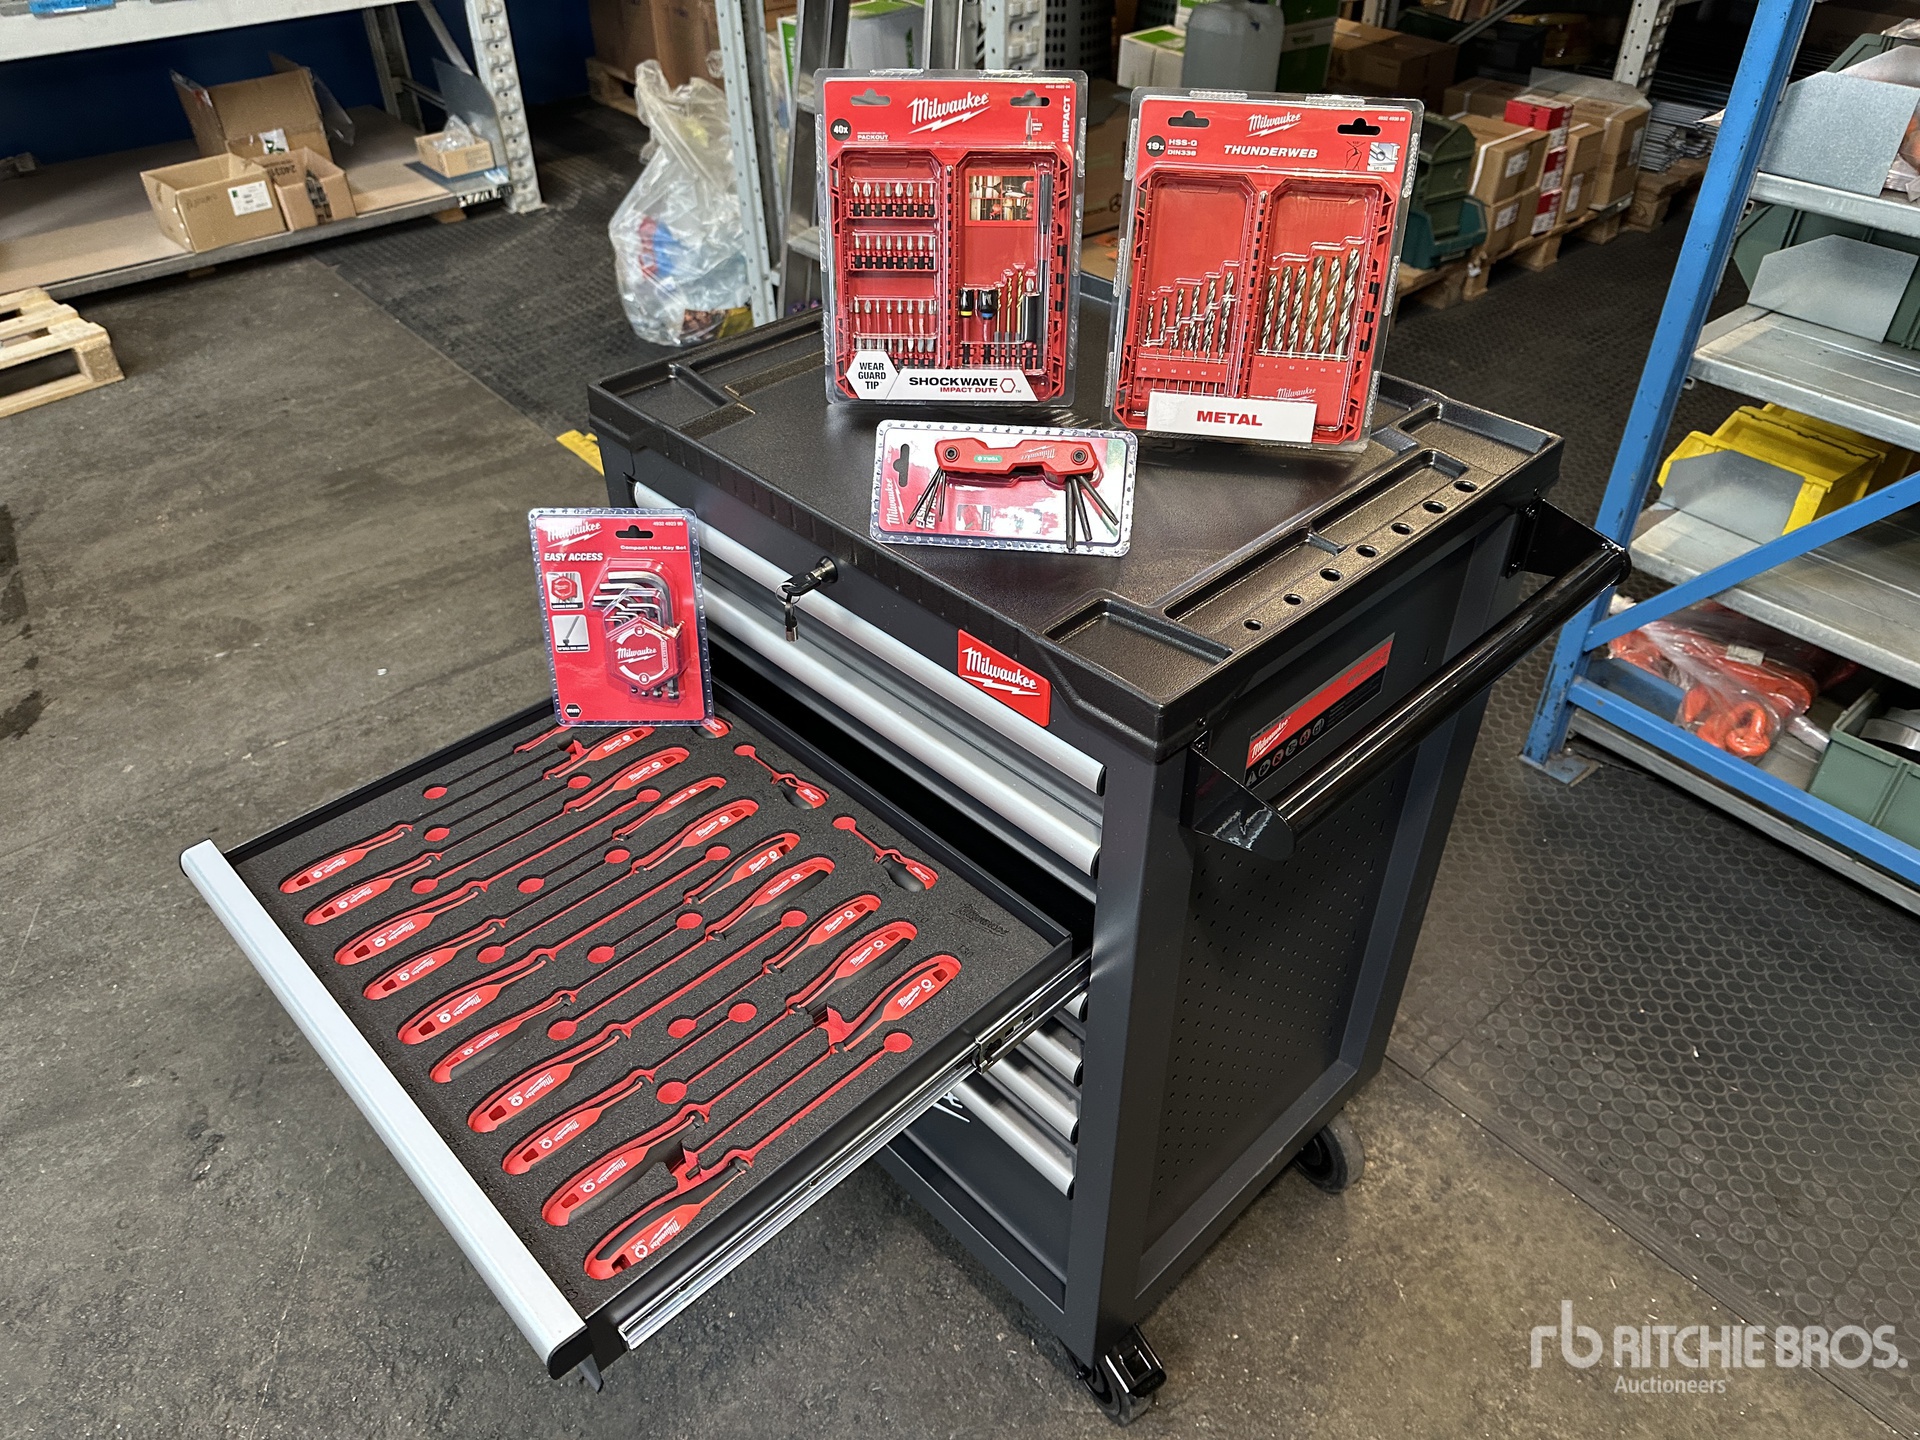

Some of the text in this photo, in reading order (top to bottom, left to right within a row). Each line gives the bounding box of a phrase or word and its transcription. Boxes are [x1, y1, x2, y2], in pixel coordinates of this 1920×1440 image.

[906, 92, 989, 125] Milwaukee
[1062, 96, 1071, 143] IMPACT
[1247, 112, 1302, 132] Milwaukee
[834, 125, 848, 134] 40x
[1146, 142, 1164, 151] 19x
[1168, 138, 1198, 147] HSS-G
[1224, 144, 1318, 160] THUNDERWEB
[859, 362, 884, 370] WEAR
[858, 371, 886, 380] GUARD
[865, 381, 880, 390] TIP
[909, 377, 998, 387] SHOCKWAVE
[1276, 387, 1316, 398] Milwaukee
[1196, 410, 1263, 426] METAL
[1020, 448, 1056, 461] Milwaukee
[885, 478, 900, 527] Milwaukee
[546, 522, 602, 543] Milwaukee
[544, 553, 603, 561] EASY ACCESS
[615, 647, 657, 659] Milwaukee
[962, 647, 1038, 690] Milwaukee
